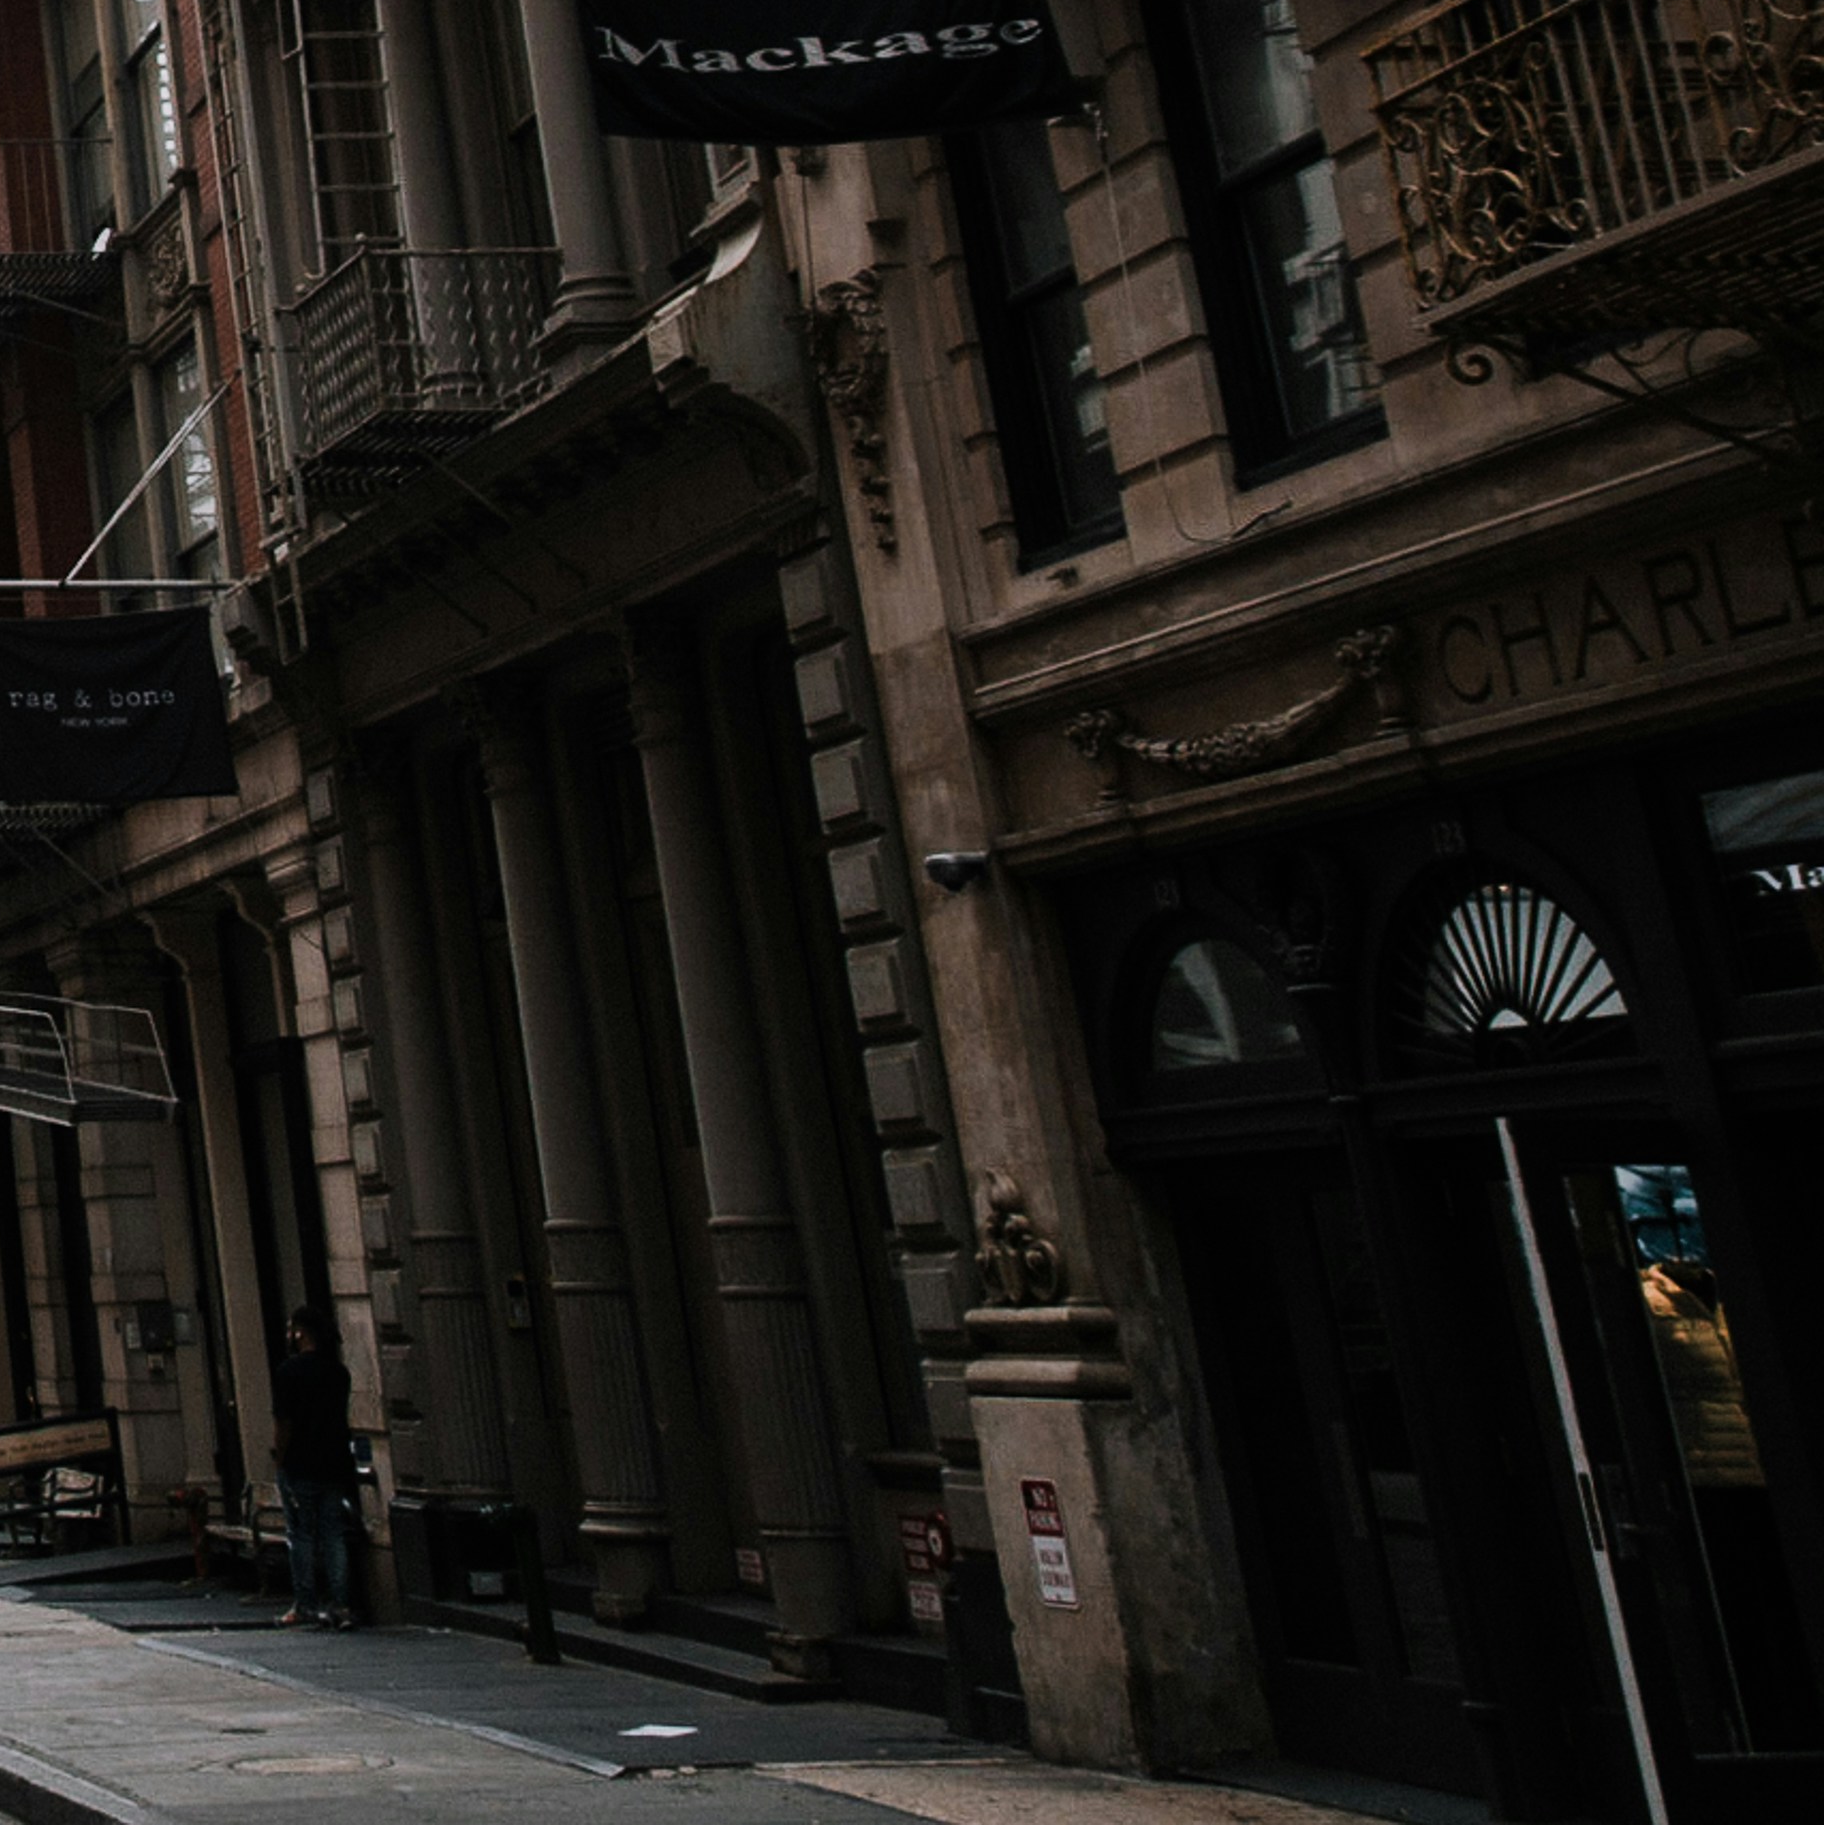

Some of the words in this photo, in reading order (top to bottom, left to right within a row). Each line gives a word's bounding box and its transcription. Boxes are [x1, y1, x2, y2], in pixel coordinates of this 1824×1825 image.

[594, 18, 1044, 74] Mackage
[8, 691, 59, 712] rag
[74, 688, 93, 708] &
[107, 688, 175, 708] bone
[60, 717, 91, 728] NEW
[94, 716, 129, 727] YORK
